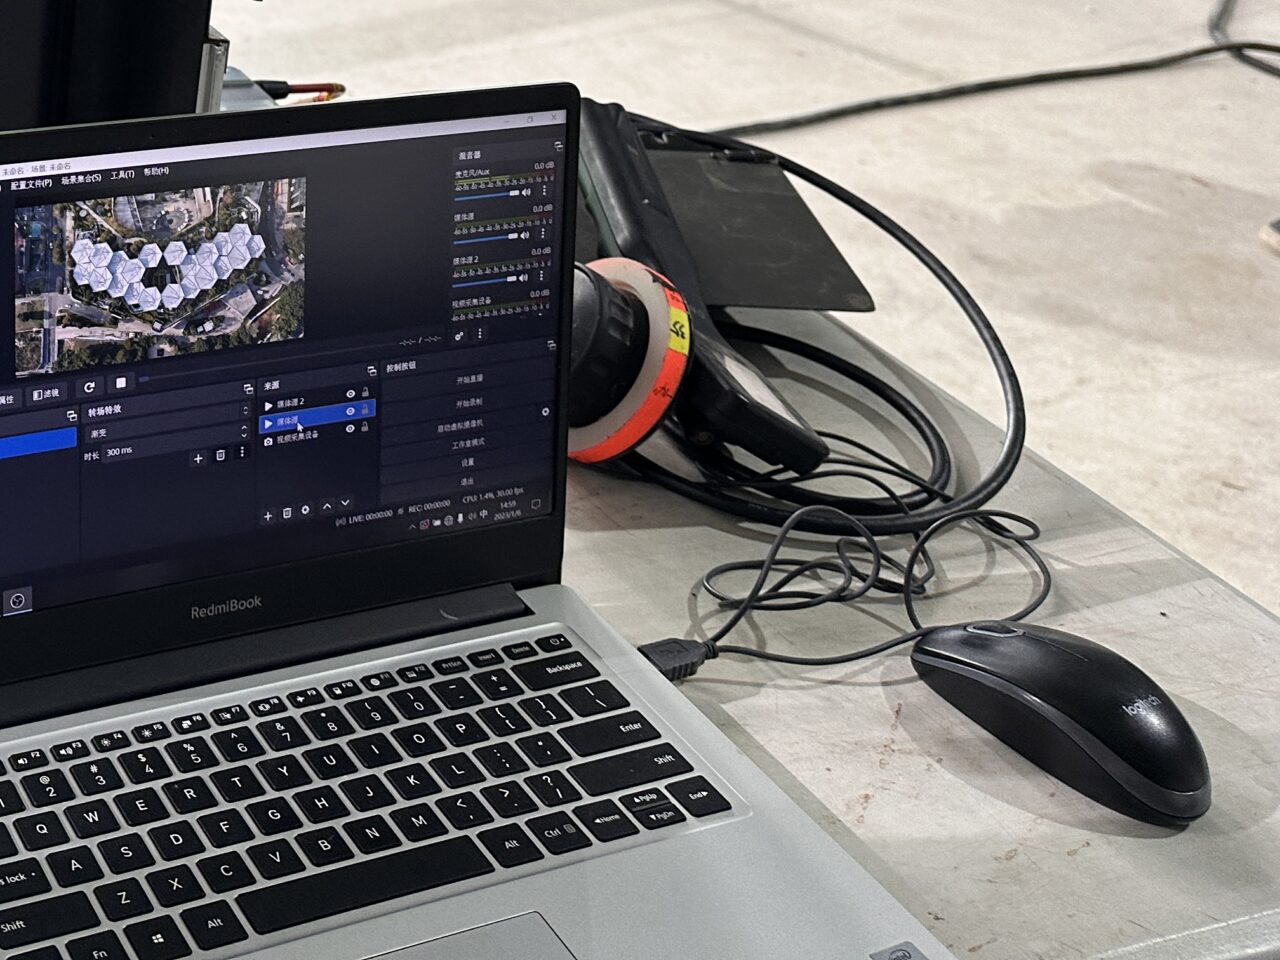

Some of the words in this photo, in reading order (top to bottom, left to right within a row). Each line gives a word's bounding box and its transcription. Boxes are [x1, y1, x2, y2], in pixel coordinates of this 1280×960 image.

[110, 169, 135, 180] 工具(T)
[10, 178, 52, 190] 配置文件(P)
[263, 380, 280, 391] 来源
[83, 450, 100, 462] 时长
[106, 447, 121, 457] 300
[122, 446, 133, 455] ms
[191, 595, 262, 620] RedmiBook
[545, 660, 583, 674] Backspace
[371, 711, 381, 721] 9
[327, 722, 337, 732] 8
[455, 723, 466, 734] P
[619, 721, 642, 733] Enter
[282, 732, 290, 742] 7
[413, 734, 425, 744] O
[237, 743, 248, 753] 6
[371, 744, 380, 754] I
[191, 753, 201, 763] 5
[323, 755, 336, 766] U
[654, 754, 676, 766] Shift
[145, 764, 154, 774] 4
[277, 766, 289, 777] Y
[451, 764, 465, 775] L
[95, 775, 106, 785] 3
[231, 776, 242, 788] T
[406, 774, 420, 786] K
[46, 787, 57, 797] 2
[183, 788, 197, 799] R
[366, 786, 374, 797] J
[640, 792, 658, 802] PgUp
[689, 792, 703, 800] End
[135, 799, 148, 811] E
[314, 797, 329, 809] H
[84, 811, 99, 823] W
[268, 809, 281, 820] G
[600, 813, 620, 824] Home
[410, 815, 427, 827] M
[35, 824, 49, 834] Q
[220, 821, 230, 833] F
[365, 827, 381, 839] N
[544, 828, 562, 838] Ctrl
[170, 833, 183, 845] D
[504, 839, 520, 850] Alt
[318, 839, 332, 851] B
[120, 846, 133, 858] S
[268, 851, 281, 863] V
[71, 859, 83, 871] A
[220, 865, 233, 877] C
[6, 873, 27, 884] lock
[168, 877, 183, 890] X
[117, 891, 131, 904] Z
[0, 920, 27, 933] Shift
[207, 918, 223, 929] Alt
[92, 950, 108, 960] Fn
